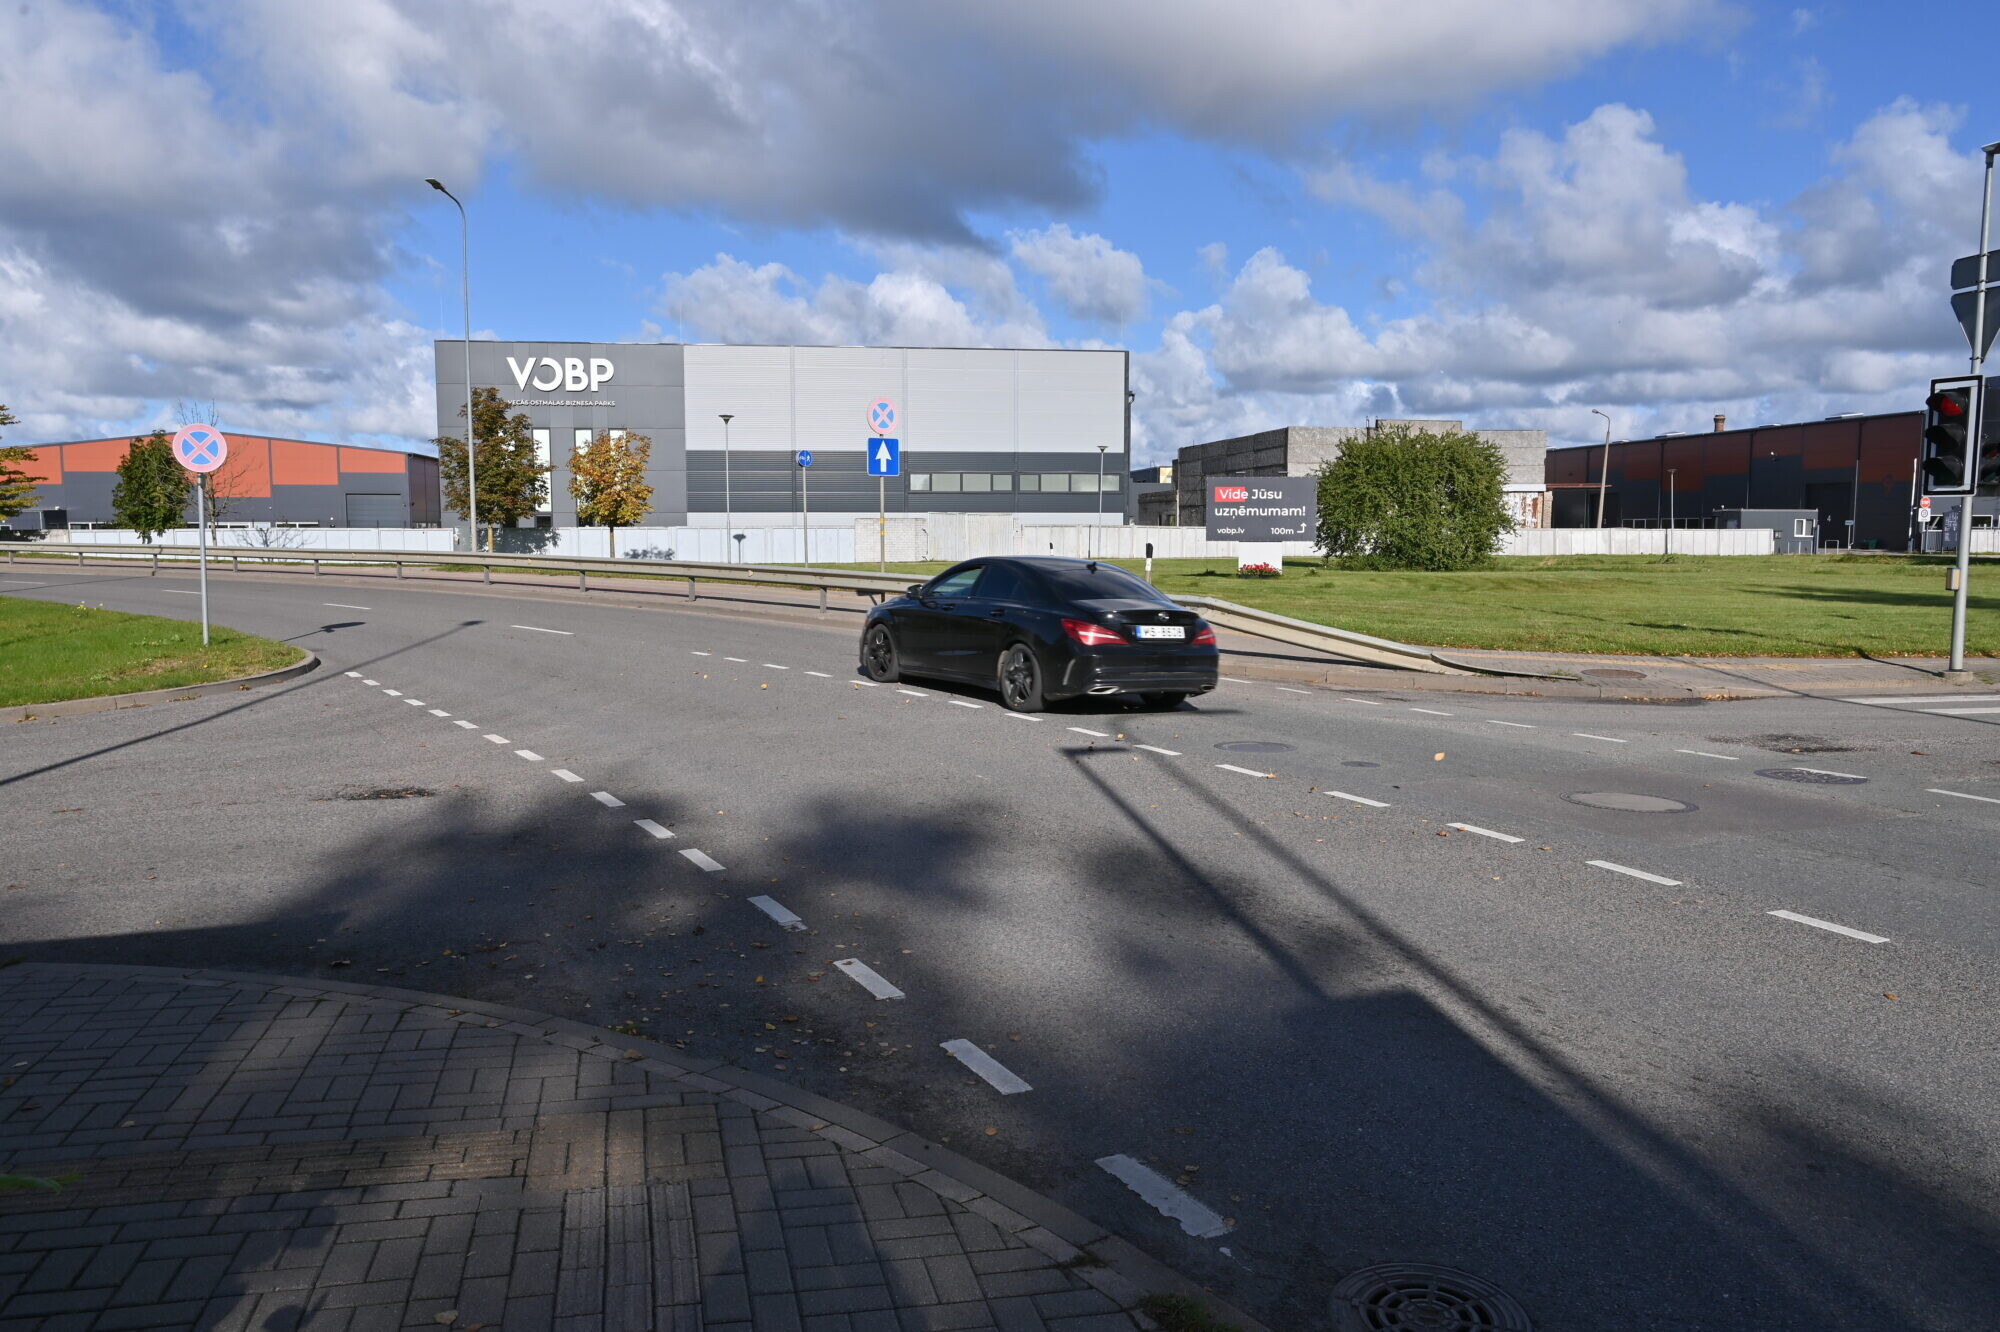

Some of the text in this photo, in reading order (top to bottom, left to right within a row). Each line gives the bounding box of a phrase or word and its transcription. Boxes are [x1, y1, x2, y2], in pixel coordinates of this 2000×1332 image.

[506, 357, 614, 392] VOBP
[1220, 489, 1282, 499] Vide Jūsu
[1215, 506, 1306, 520] uzņēmumam!
[1217, 526, 1245, 535] vobp.lv
